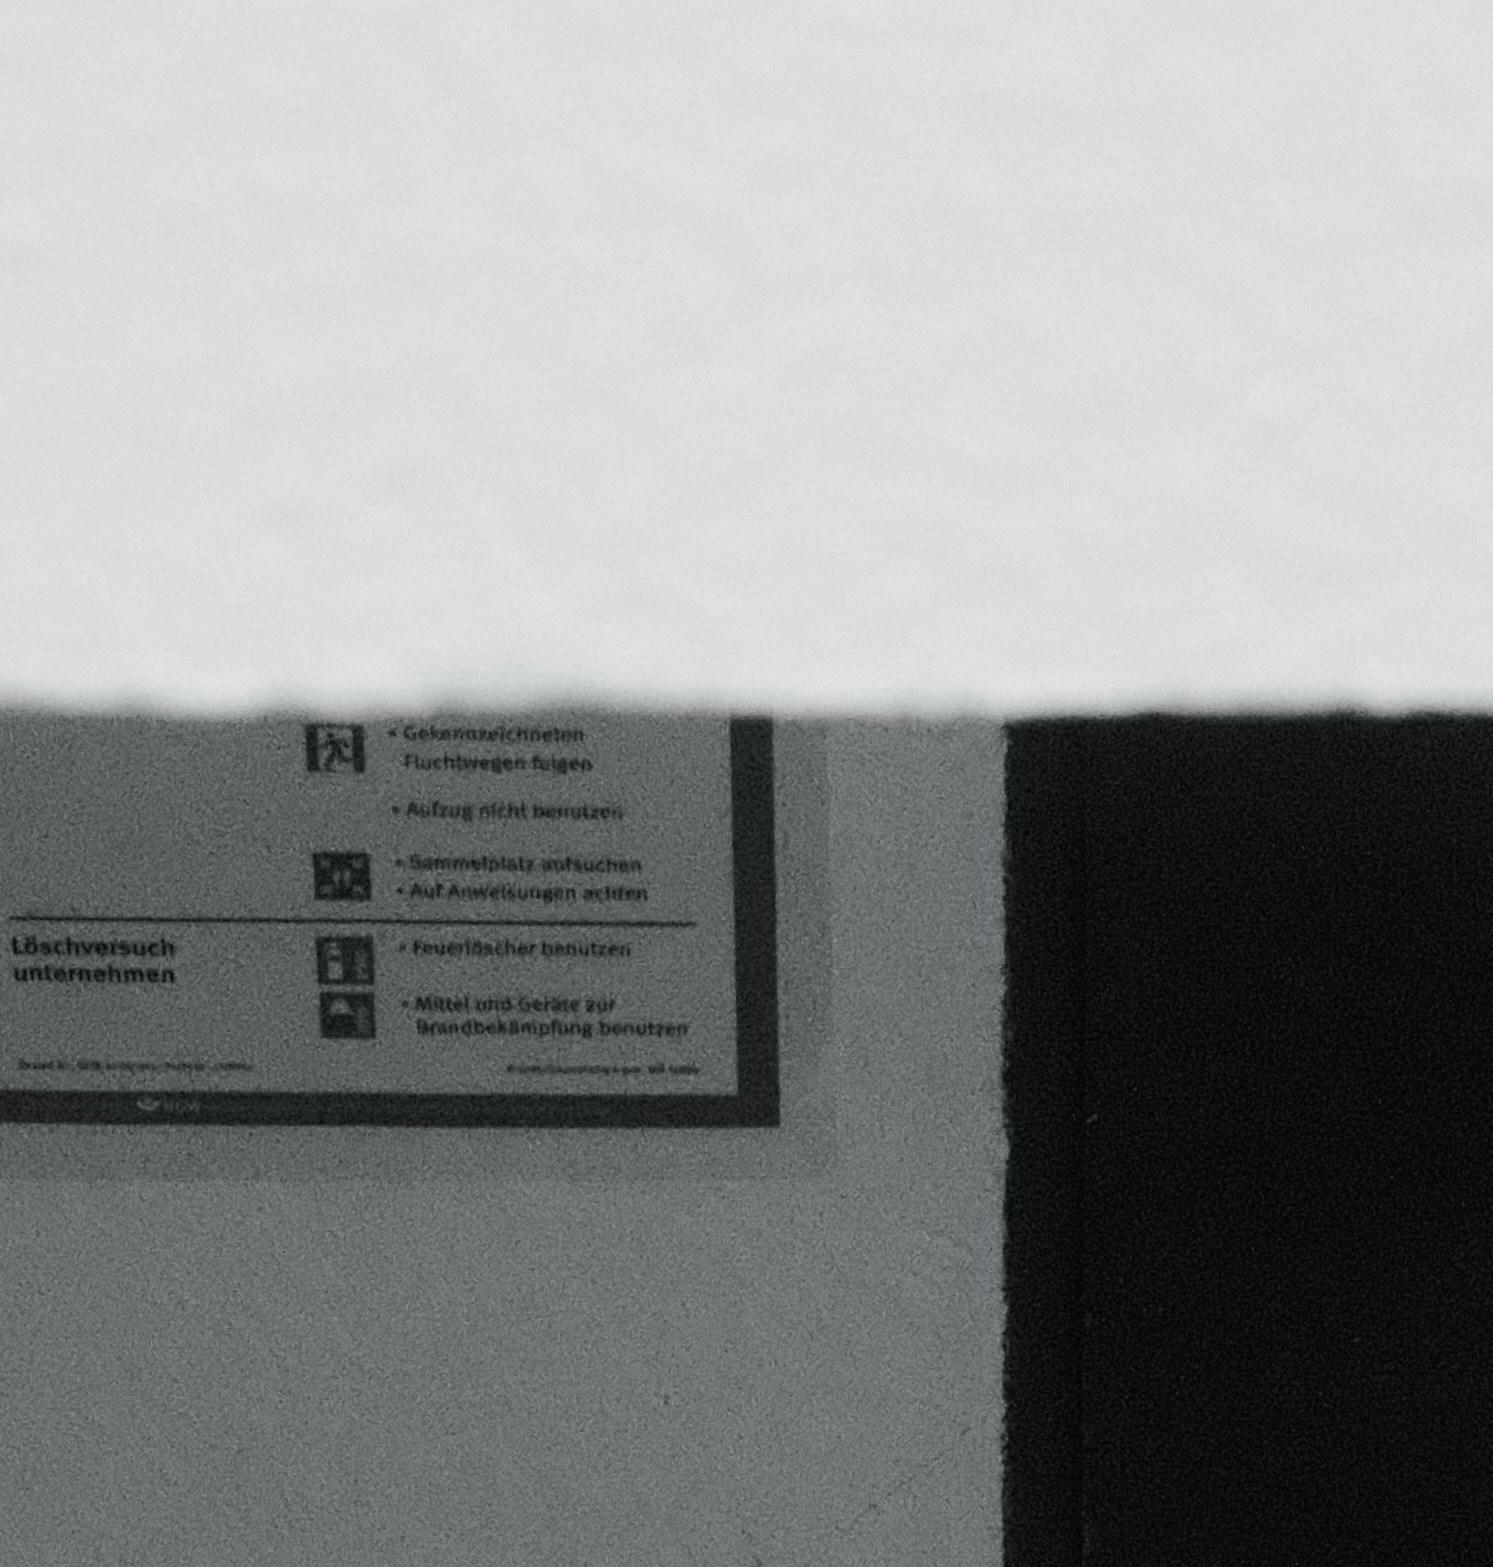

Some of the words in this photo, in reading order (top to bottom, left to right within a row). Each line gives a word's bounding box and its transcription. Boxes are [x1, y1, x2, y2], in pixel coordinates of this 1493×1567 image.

[402, 725, 585, 742] Gekennzeichneten
[403, 754, 527, 774] Fluchtwegen
[531, 755, 594, 775] folgen
[406, 802, 472, 822] Aufzug
[479, 803, 527, 820] nicht
[532, 803, 624, 821] benutzen
[408, 854, 535, 873] Sammelplatz
[540, 856, 643, 873] aufsuchen
[409, 883, 441, 901] Auf
[448, 883, 577, 903] Anweisungen
[582, 884, 650, 902] achten
[11, 937, 177, 956] Löschversuch
[412, 939, 537, 957] Feuerlöscher
[540, 940, 632, 957] benutzen
[13, 964, 177, 983] unternehmen
[415, 995, 469, 1012] Mittel
[475, 995, 512, 1012] und
[517, 995, 580, 1012] Geräte
[585, 998, 616, 1012] zur
[416, 1018, 593, 1038] Brandbekämpfung
[598, 1019, 690, 1037] benutzen
